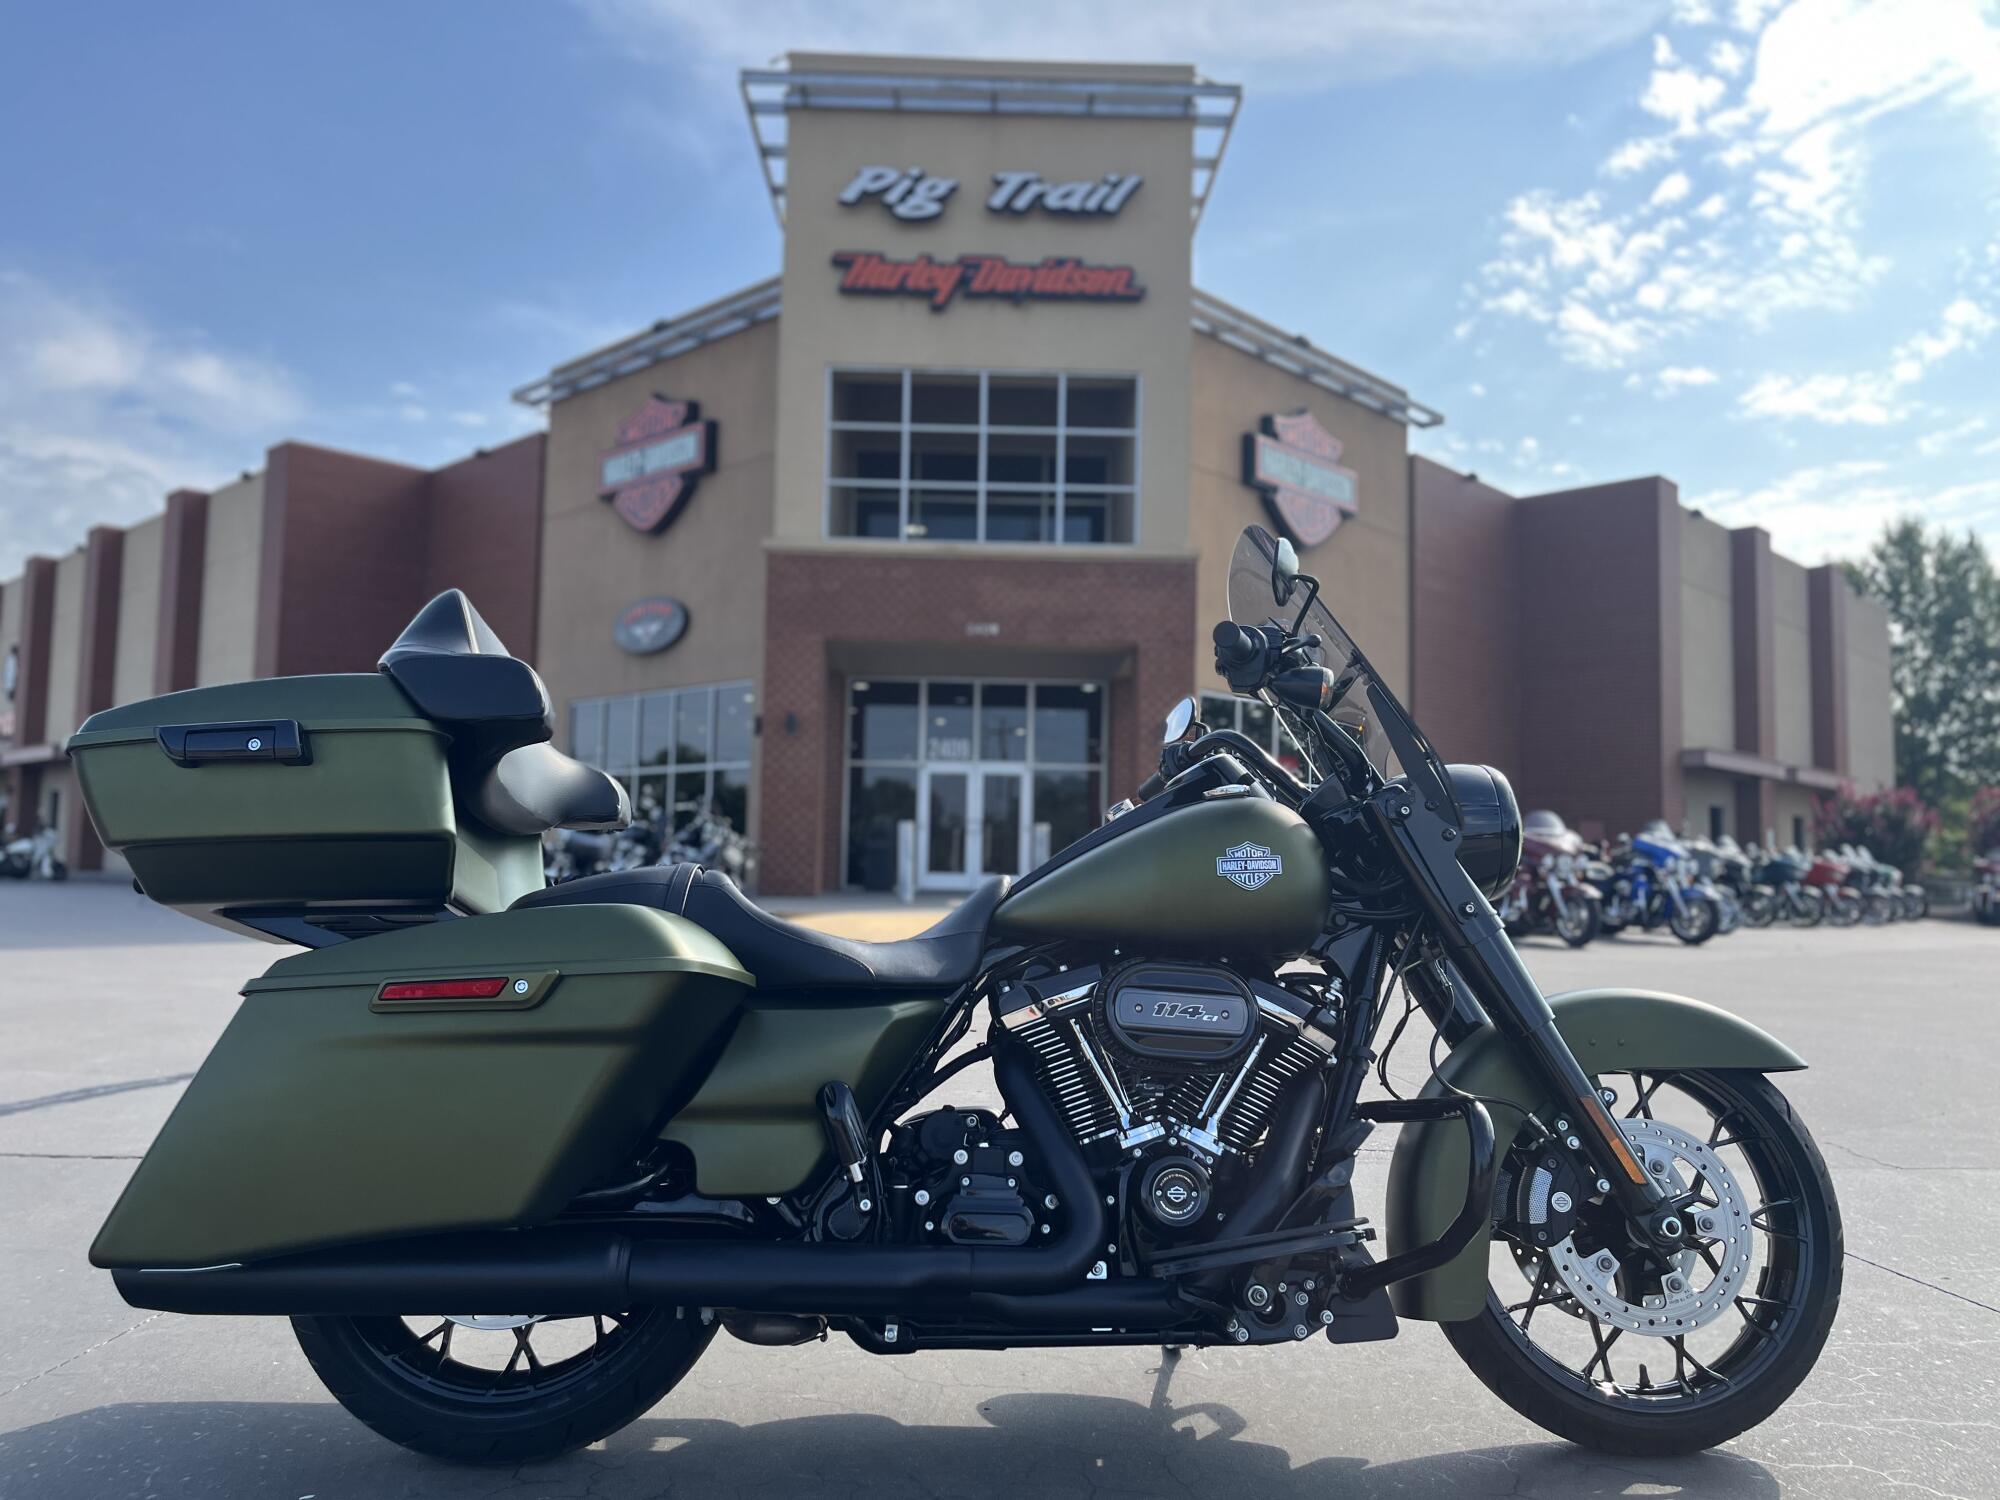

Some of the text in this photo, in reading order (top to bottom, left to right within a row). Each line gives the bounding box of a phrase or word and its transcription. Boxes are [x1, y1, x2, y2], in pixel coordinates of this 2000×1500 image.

[838, 166, 1142, 220] Pig Trail
[1233, 847, 1264, 858] MOTOR
[1222, 860, 1277, 871] HARLEY-DAVIDSON
[1235, 873, 1265, 885] CYCLES
